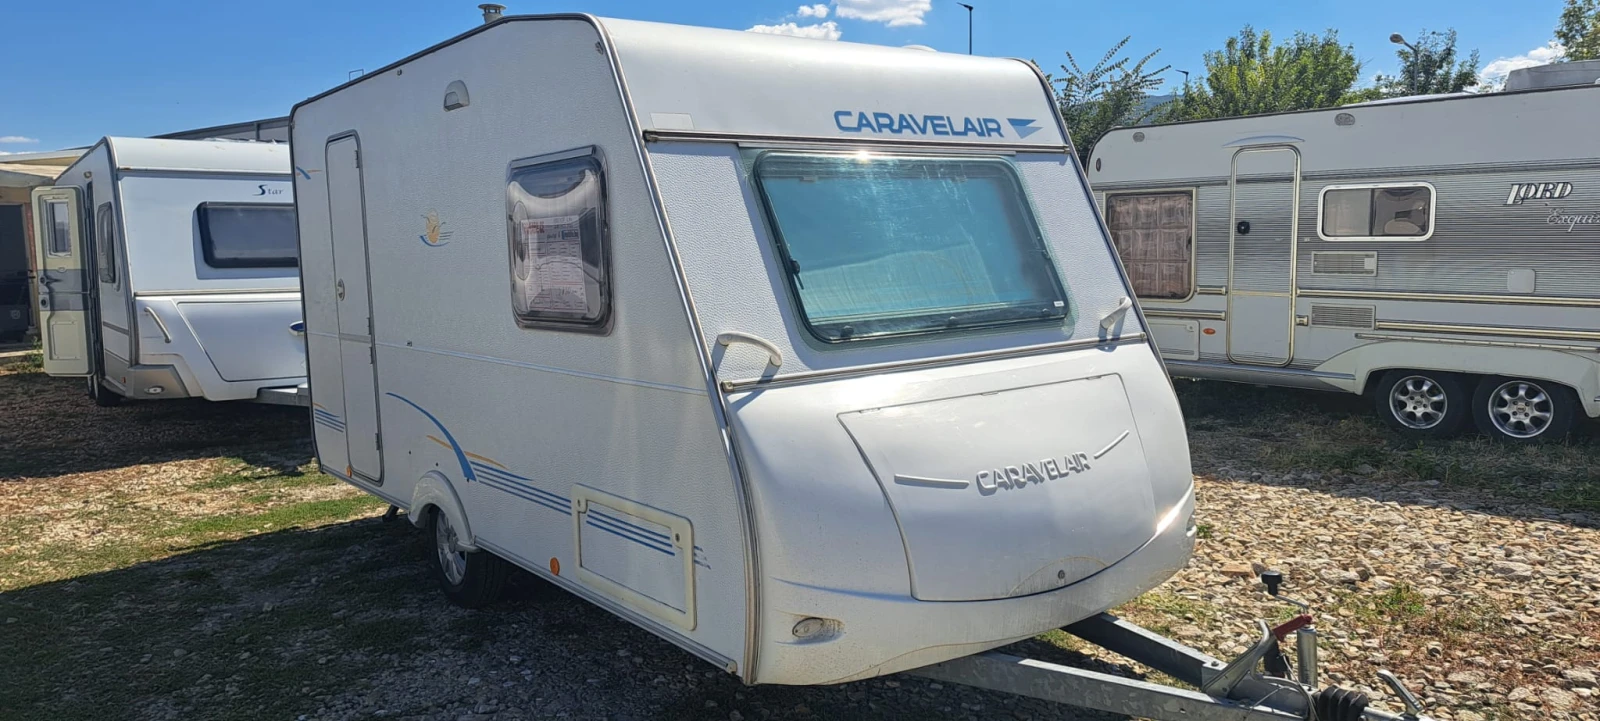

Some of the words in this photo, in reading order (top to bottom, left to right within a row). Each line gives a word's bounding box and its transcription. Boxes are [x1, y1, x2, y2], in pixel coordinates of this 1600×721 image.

[834, 110, 1004, 138] CARAVELAIR
[252, 184, 284, 196] Star
[1505, 182, 1574, 206] LORD
[976, 451, 1091, 496] CARAVELAIR
